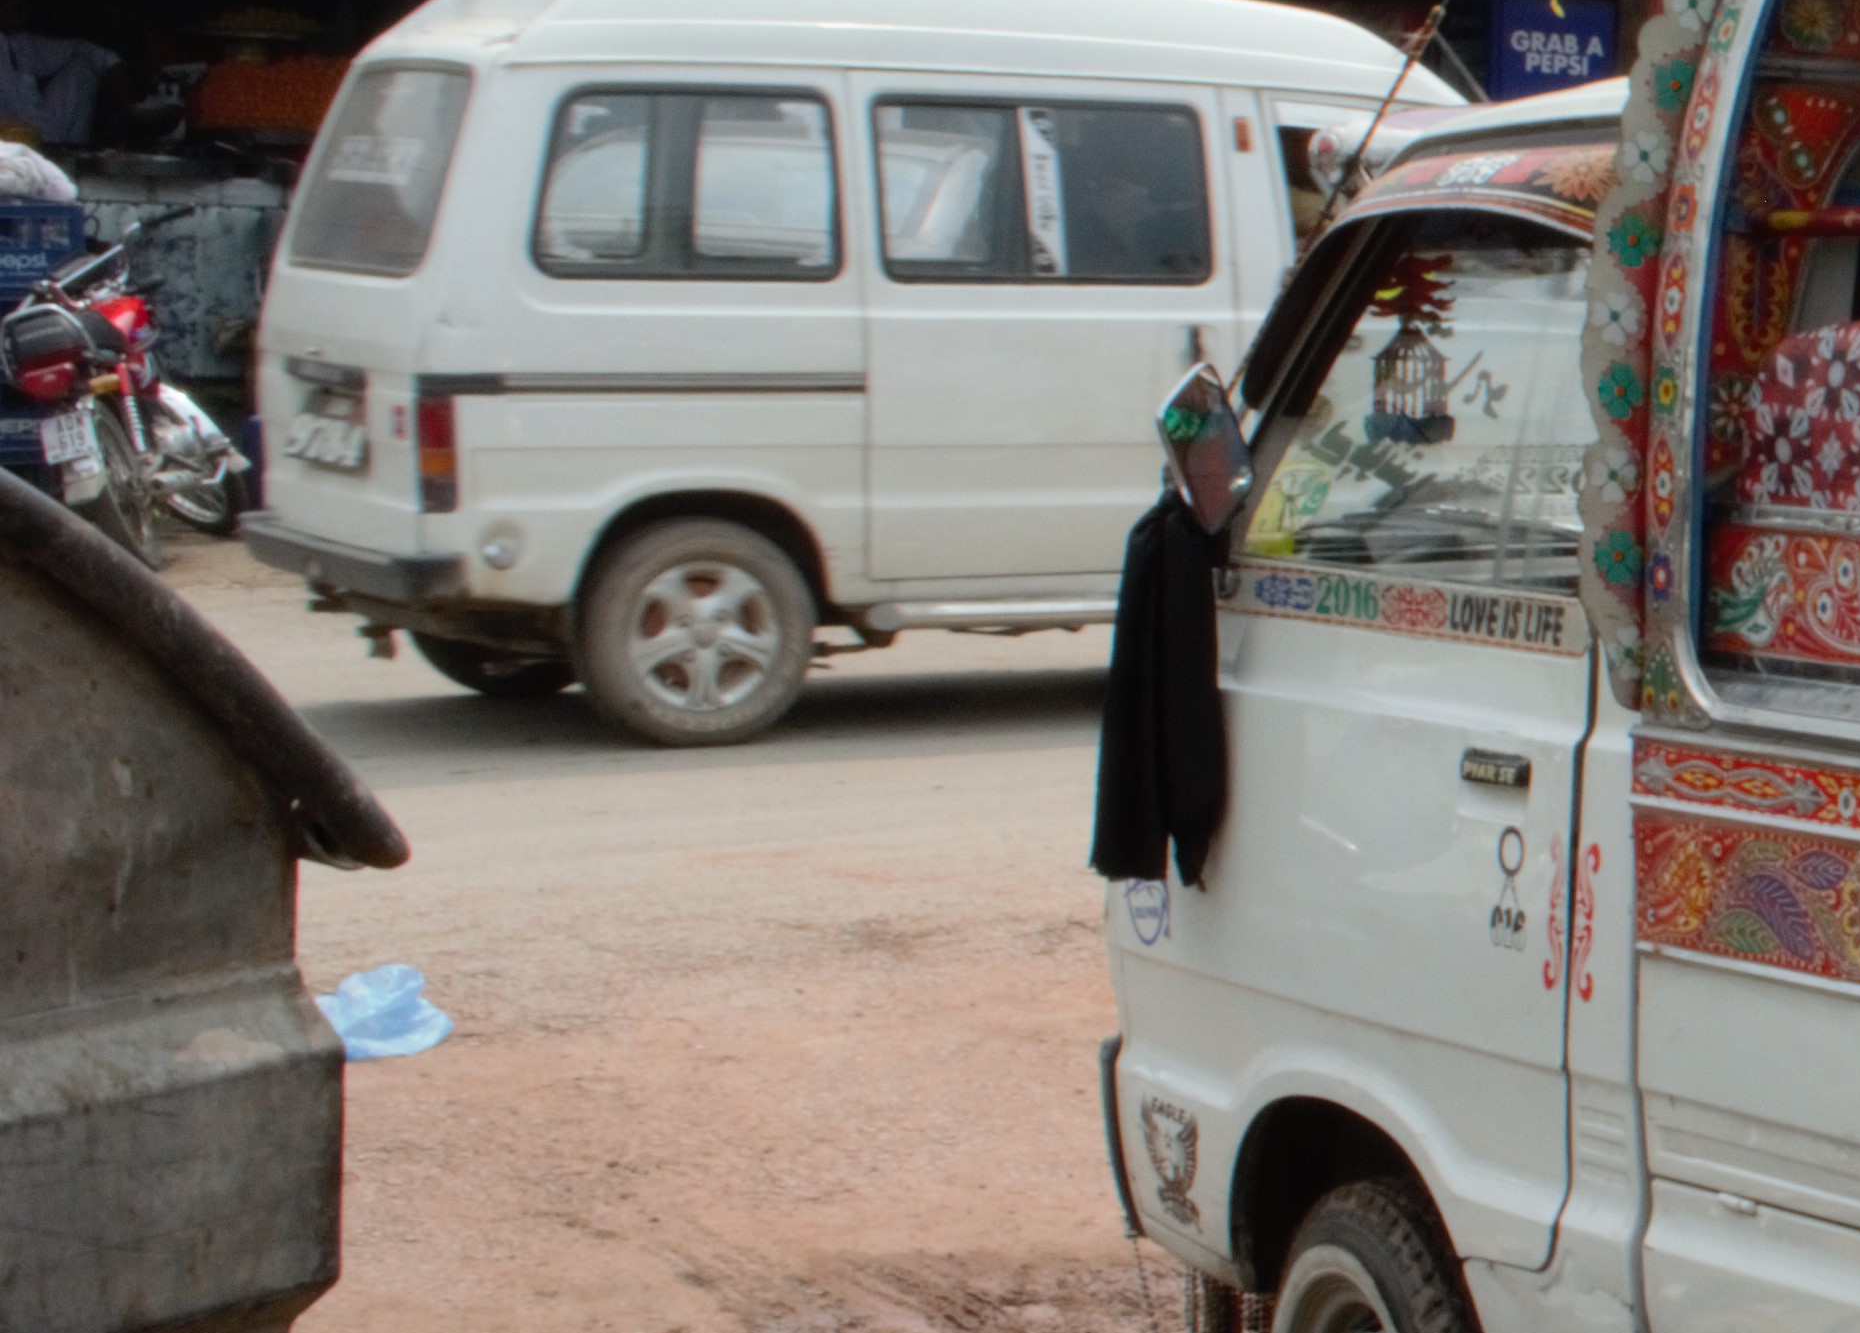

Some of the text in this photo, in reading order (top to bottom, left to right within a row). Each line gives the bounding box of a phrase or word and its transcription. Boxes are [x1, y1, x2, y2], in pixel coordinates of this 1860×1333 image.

[1510, 28, 1604, 58] GRAB A
[1525, 51, 1590, 76] PEPSI
[1315, 575, 1379, 621] 2016
[1449, 592, 1566, 647] LOVE IS LIFE
[1150, 1096, 1187, 1125] EAGLE
